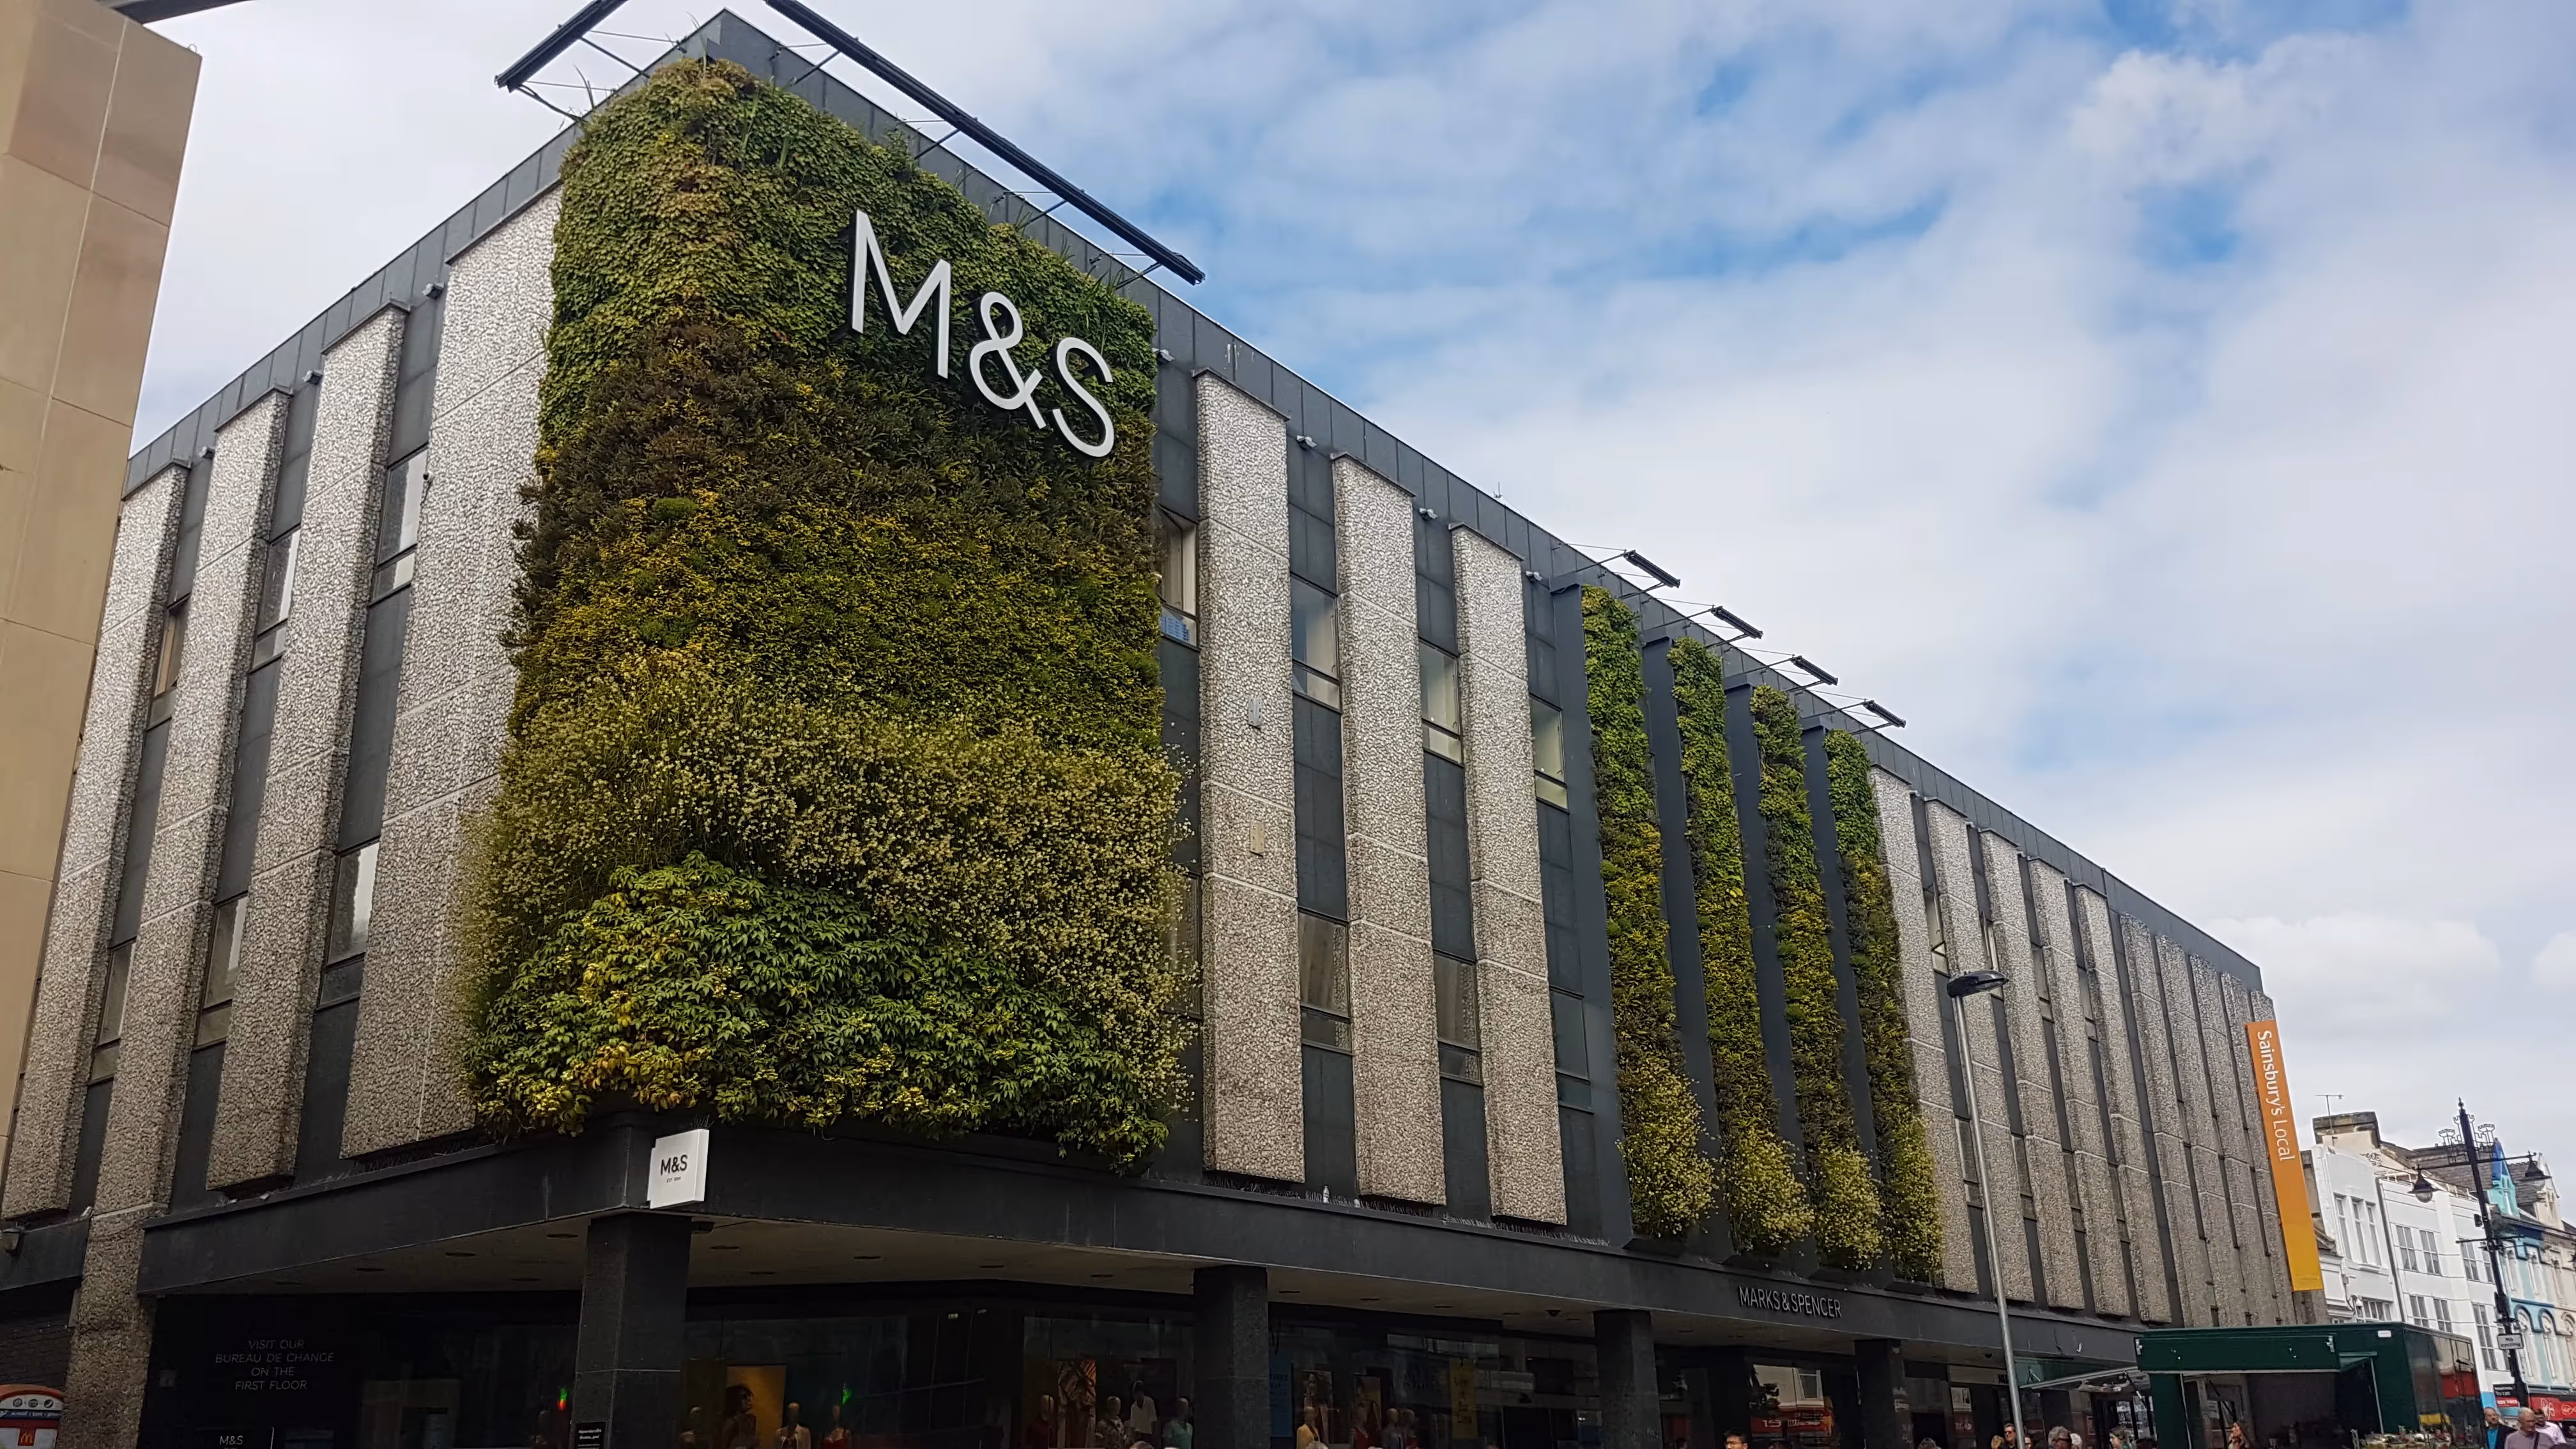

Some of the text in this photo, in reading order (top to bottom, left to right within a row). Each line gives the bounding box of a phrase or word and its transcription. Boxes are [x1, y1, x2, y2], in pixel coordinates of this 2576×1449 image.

[851, 209, 1115, 457] M&S
[2257, 1031, 2295, 1162] Sainsbury's Local
[660, 1154, 688, 1176] M&S
[1738, 1285, 1842, 1318] MARKS & SPENCER
[247, 1339, 305, 1350] VISIT OUR
[215, 1352, 335, 1363] BUREAU DE CHANGE
[250, 1367, 295, 1377] ON THE
[235, 1380, 307, 1390] FIRST FLOOR
[219, 1435, 243, 1445] M&S
